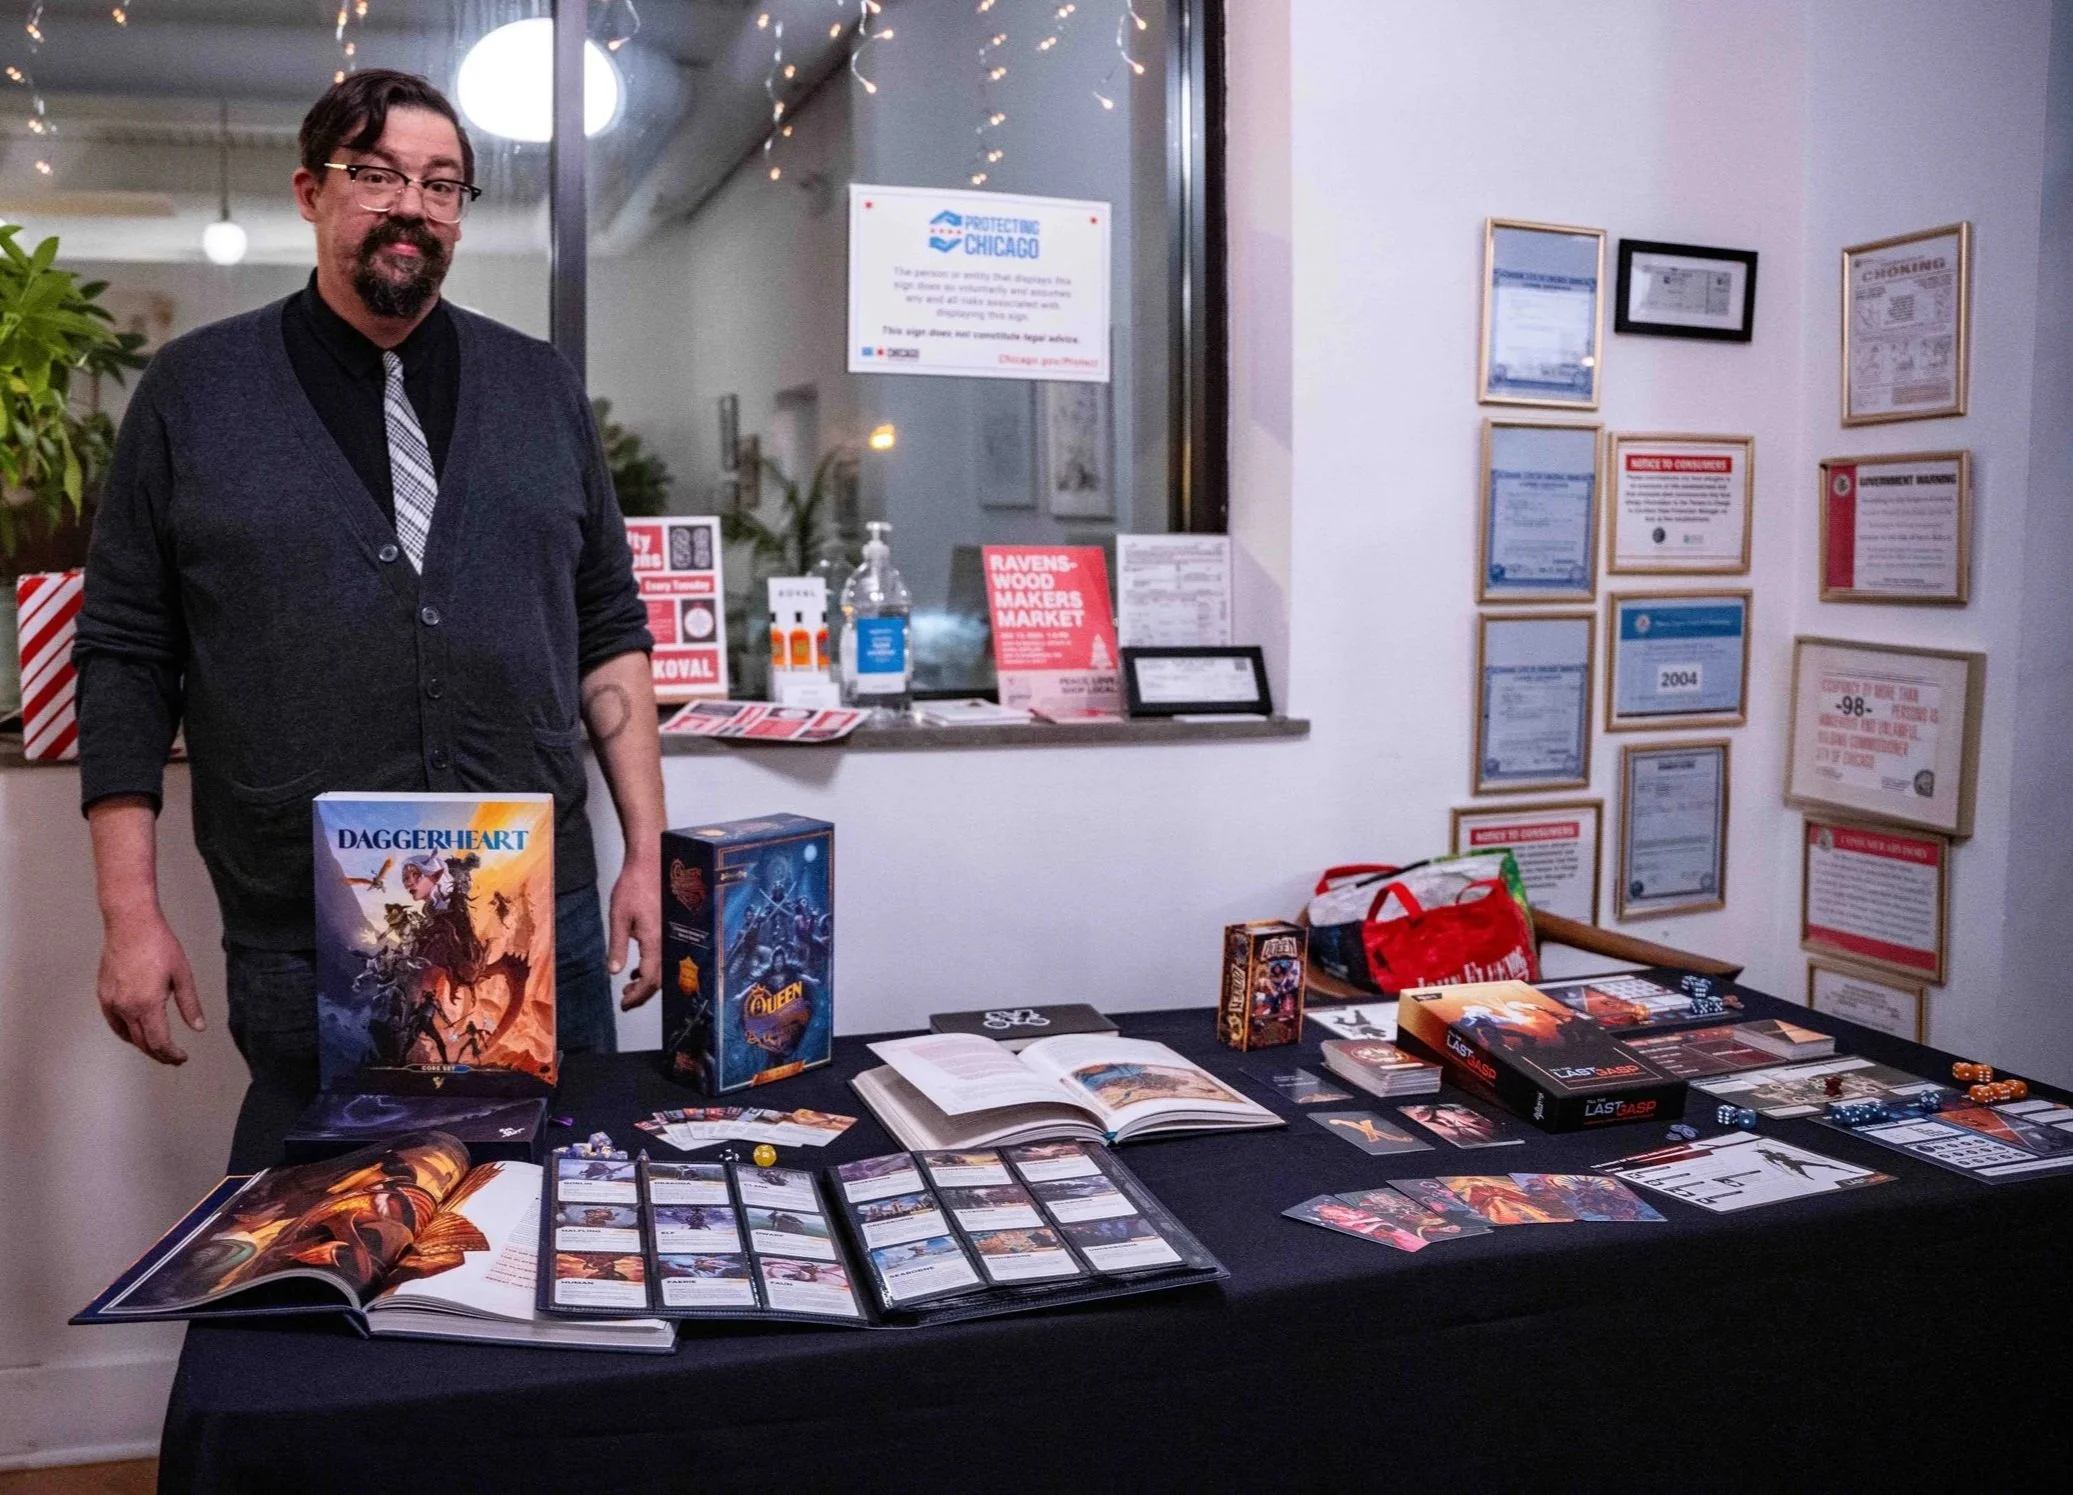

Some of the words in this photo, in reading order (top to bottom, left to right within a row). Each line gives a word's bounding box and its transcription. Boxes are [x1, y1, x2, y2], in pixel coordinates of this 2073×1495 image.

[965, 215, 1040, 234] PROTECTING
[964, 233, 1039, 259] CHICAGO
[1862, 257, 1945, 282] CHOKING
[882, 325, 902, 335] This
[906, 327, 926, 338] sign
[929, 328, 951, 337] does
[1631, 457, 1661, 470] NOTICE
[1662, 458, 1673, 469] TO
[1674, 458, 1727, 471] CONSUMERS
[990, 554, 1078, 572] RAVENS-
[992, 573, 1055, 590] WOOD
[994, 590, 1084, 609] MAKERS
[996, 609, 1086, 628] MARKET
[652, 658, 713, 679] KOVAL
[1661, 671, 1698, 687] 2004
[1835, 695, 1873, 717] -98-
[338, 829, 529, 850] DAGGERHEART
[750, 981, 803, 1016] QUEEN
[1447, 1034, 1474, 1057] LAST
[1466, 1055, 1497, 1080] GASP
[1553, 1067, 1595, 1079] LAST
[1596, 1064, 1640, 1077] GASP
[1585, 1101, 1625, 1117] LAST
[1616, 1101, 1657, 1117] GASP
